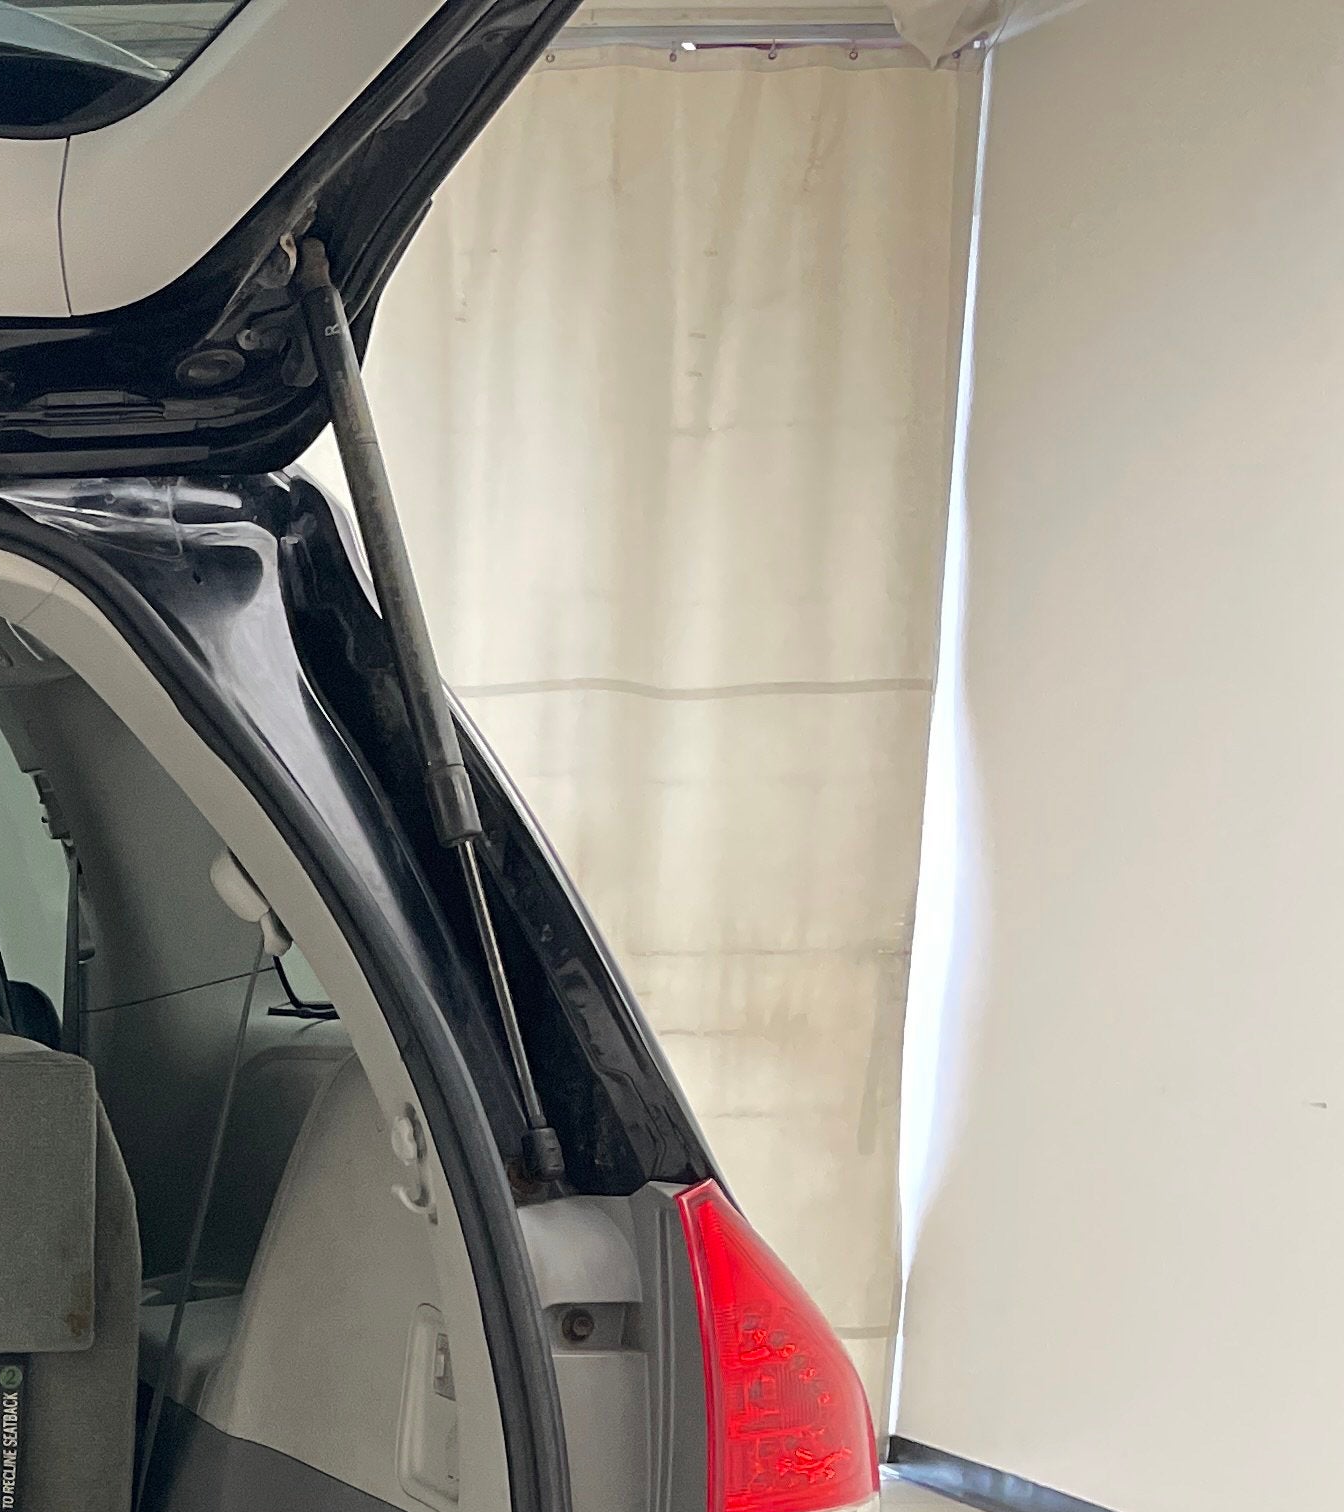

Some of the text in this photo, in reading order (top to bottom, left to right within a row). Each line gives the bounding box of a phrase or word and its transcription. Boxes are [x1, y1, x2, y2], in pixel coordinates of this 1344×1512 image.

[2, 1392, 18, 1509] TO RECLINE SEATBACK
